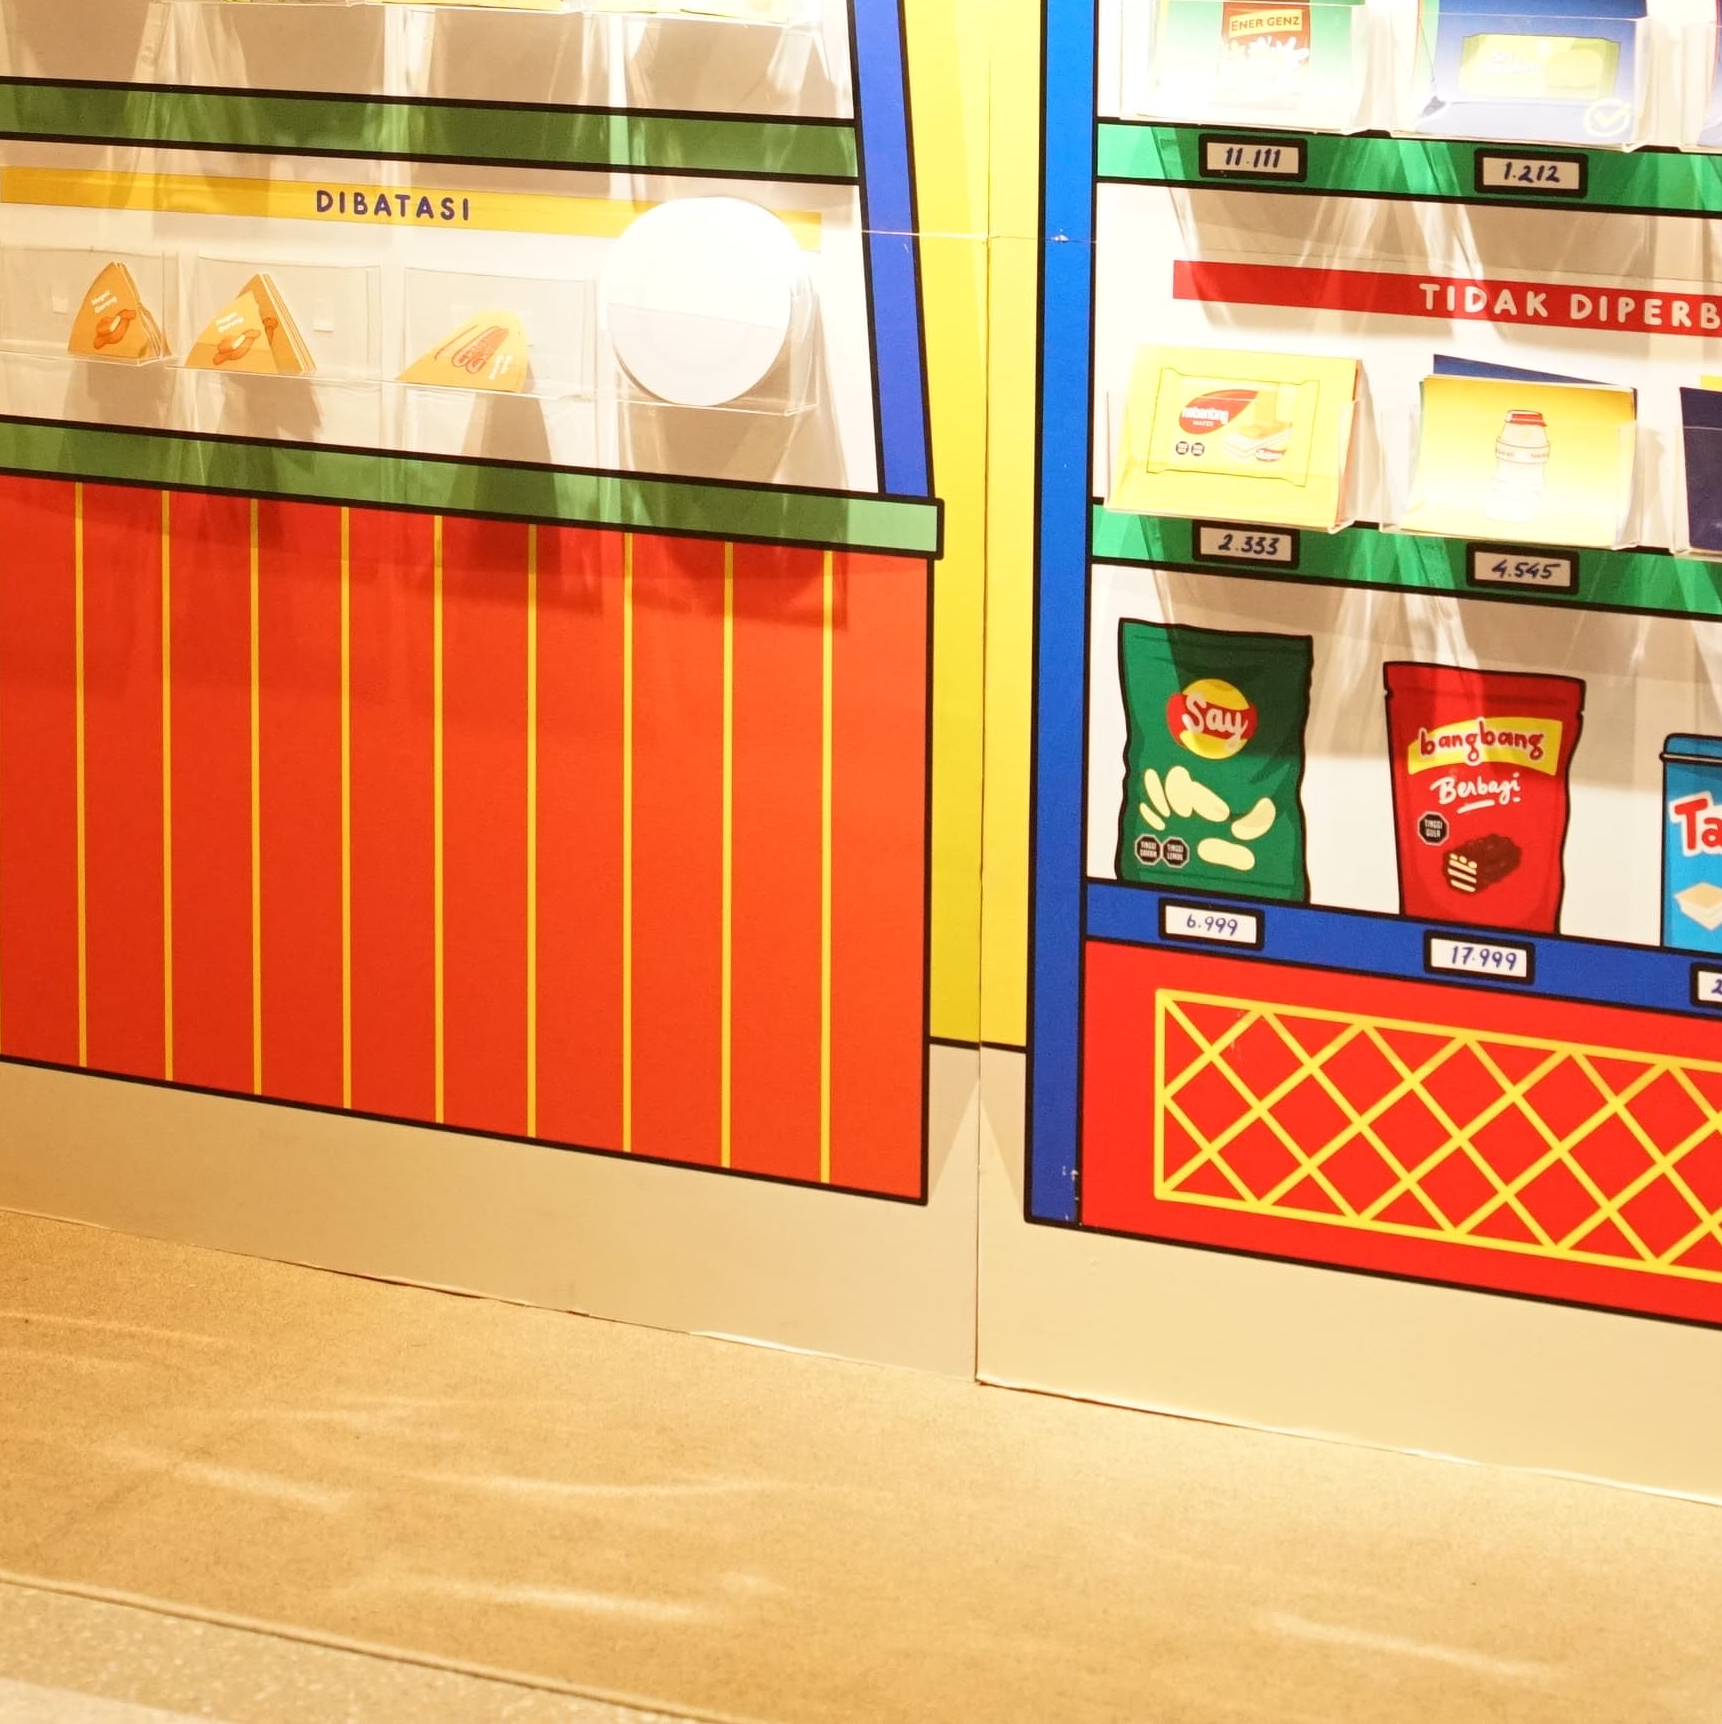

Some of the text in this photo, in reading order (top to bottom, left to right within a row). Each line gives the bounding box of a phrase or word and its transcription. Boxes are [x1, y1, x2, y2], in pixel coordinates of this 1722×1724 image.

[1231, 16, 1300, 32] ENER GENZ
[1225, 147, 1282, 169] 11.111
[1504, 162, 1561, 183] 1.212
[315, 189, 471, 222] DIBATASI
[1420, 283, 1549, 319] TIDAK
[1218, 534, 1280, 556] 2.333
[1492, 559, 1561, 579] 4.545
[1181, 690, 1249, 752] Say
[1419, 718, 1545, 763] bangbang
[1429, 772, 1521, 805] Berbagi
[1186, 914, 1238, 937] 6.999
[1451, 946, 1517, 971] 17.999
